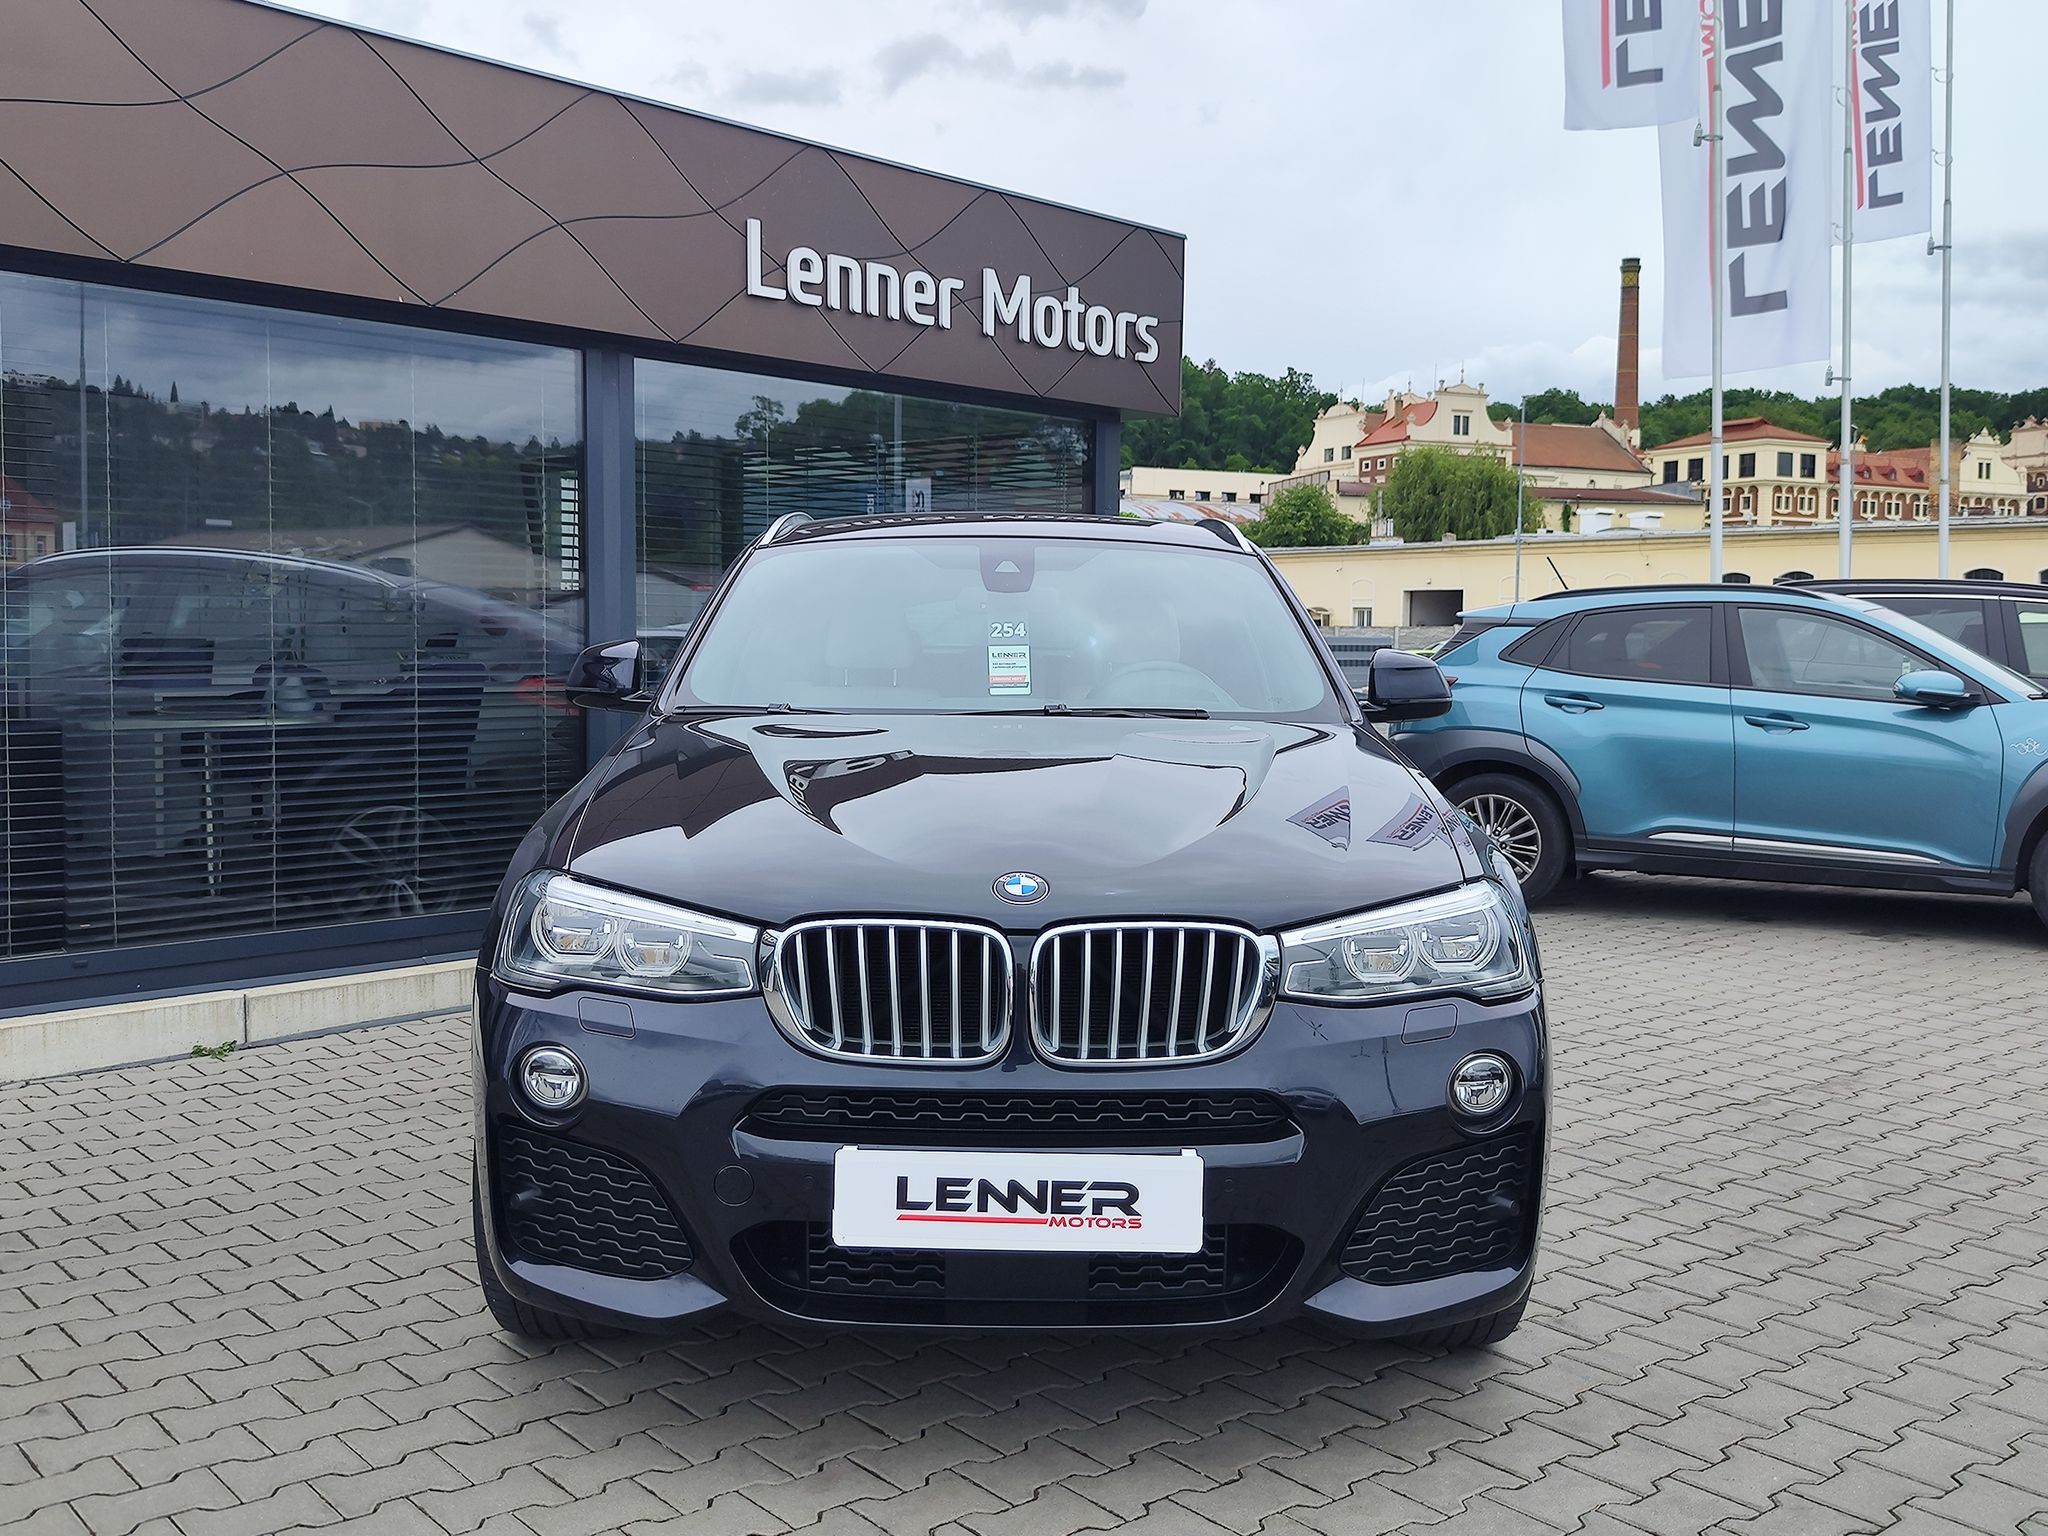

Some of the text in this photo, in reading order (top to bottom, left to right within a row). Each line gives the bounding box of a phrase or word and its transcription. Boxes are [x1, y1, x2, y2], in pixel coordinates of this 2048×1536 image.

[746, 218, 1159, 363] Lenner Motors
[990, 621, 1027, 638] 254
[896, 1175, 1142, 1216] LENNER
[1049, 1216, 1142, 1229] MOTORS
